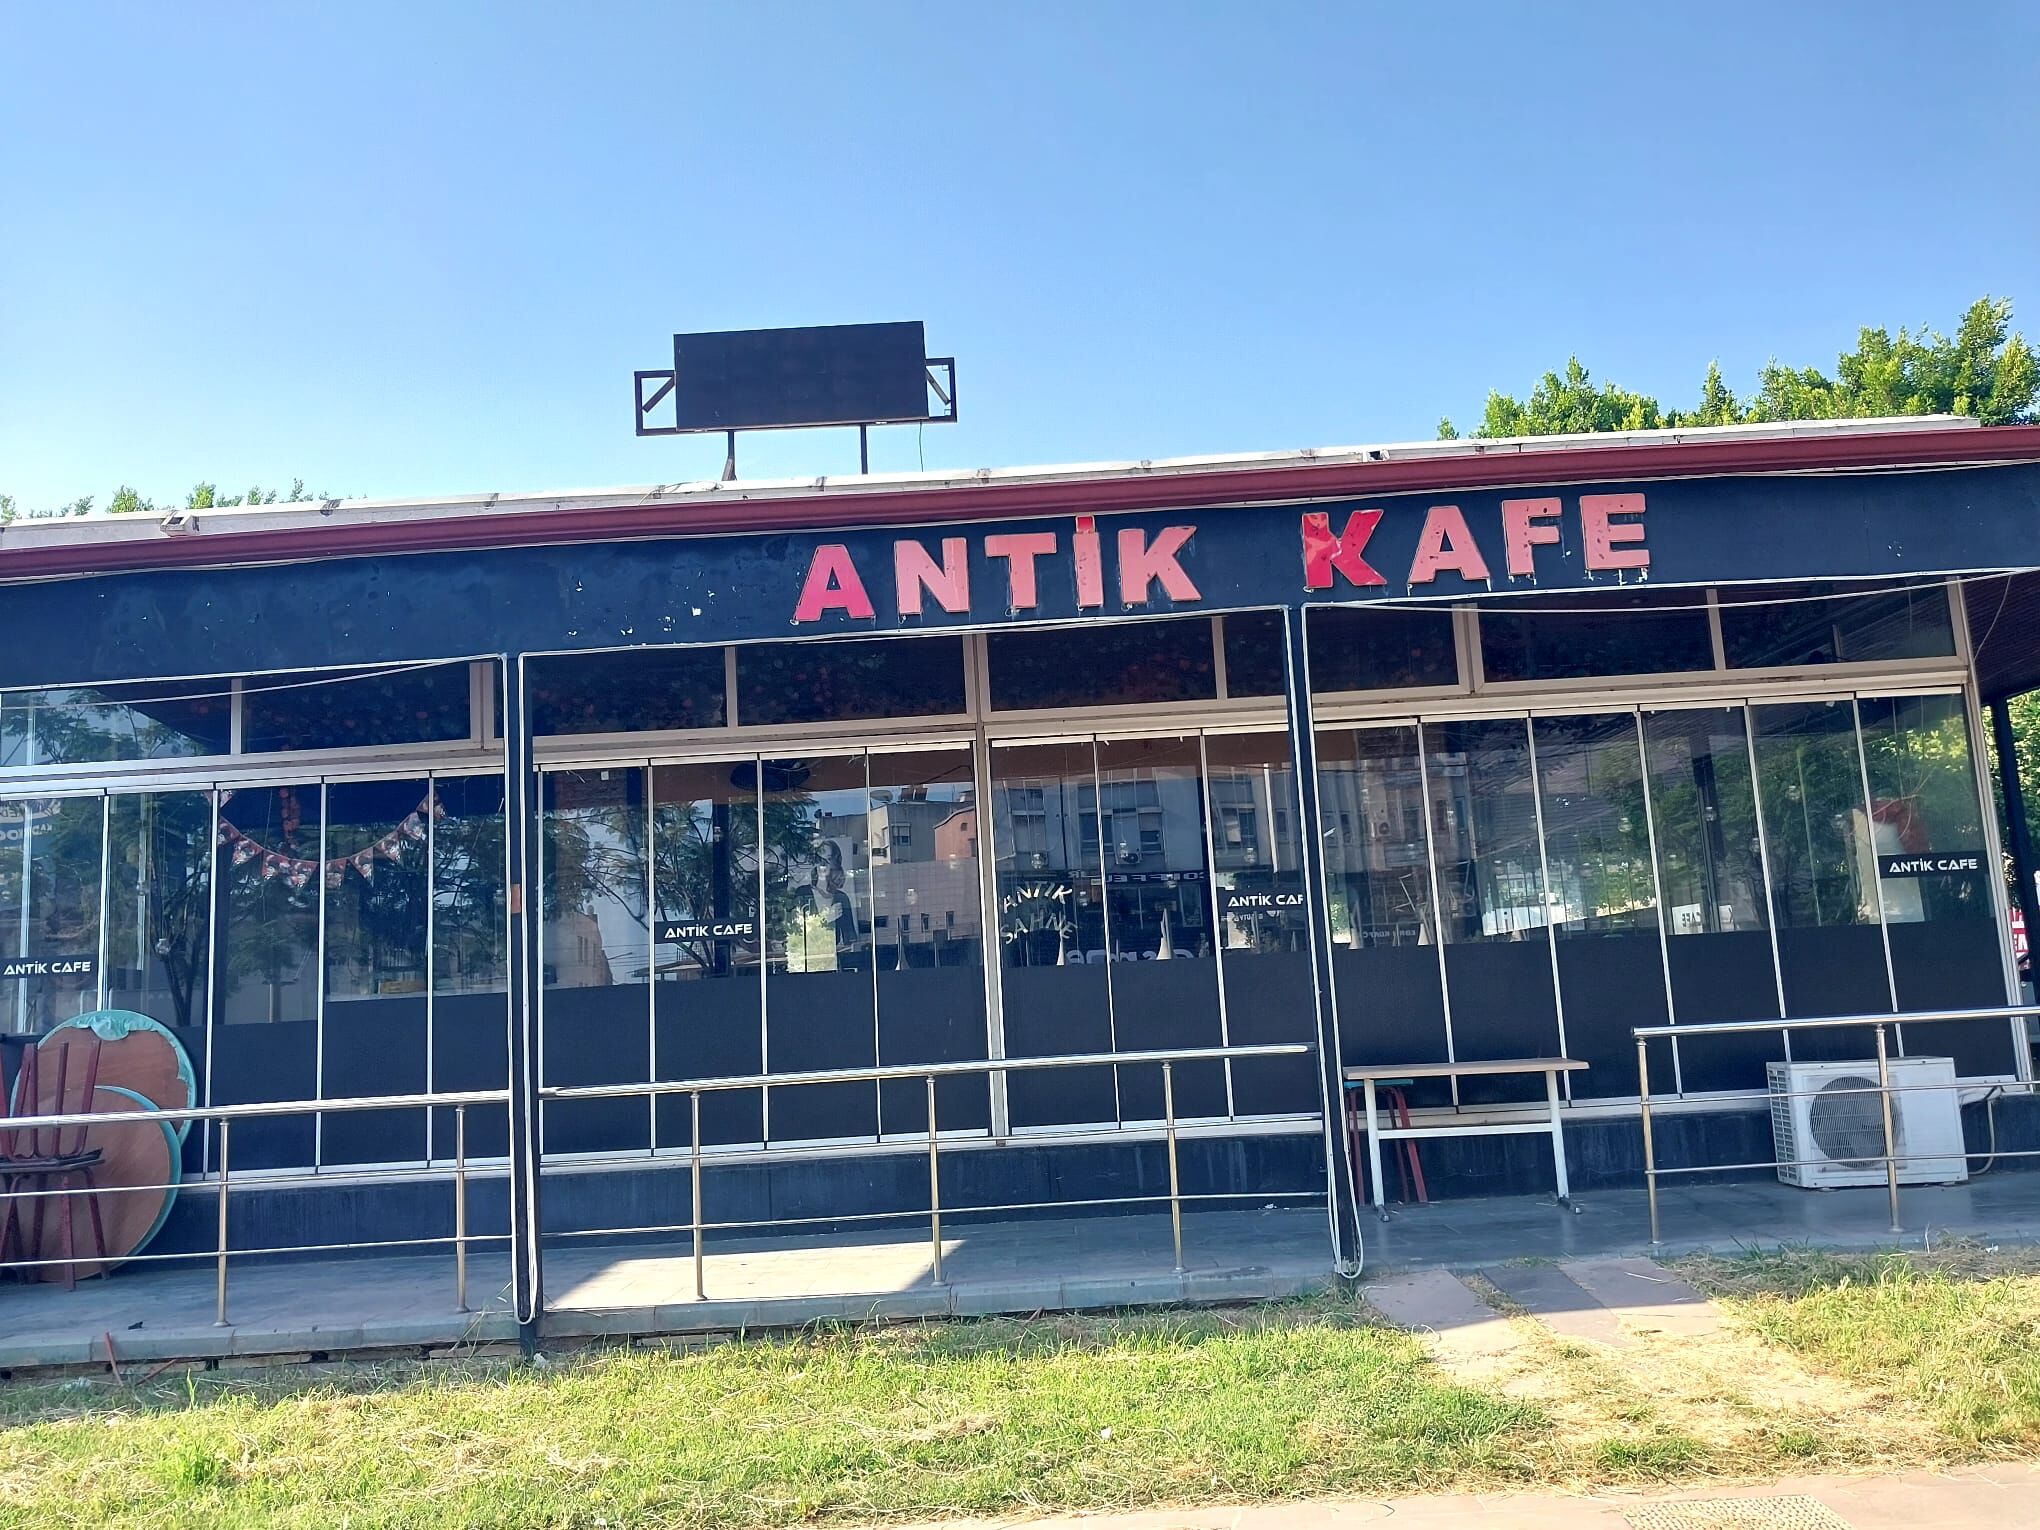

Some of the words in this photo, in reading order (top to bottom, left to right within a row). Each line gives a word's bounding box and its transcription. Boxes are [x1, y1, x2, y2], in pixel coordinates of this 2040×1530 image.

[795, 514, 1202, 622] ANTİK
[1301, 493, 1651, 589] KAFE
[1889, 857, 1934, 873] ANTİK
[1937, 858, 1978, 871] CAFE
[1228, 892, 1273, 907] ANTİK
[1275, 894, 1304, 905] CAF
[664, 923, 709, 939] ANTİK
[712, 923, 753, 936] CAFE
[1000, 909, 1078, 945] SAHNE
[3, 960, 48, 976] ANTİK
[51, 961, 91, 973] CAFE
